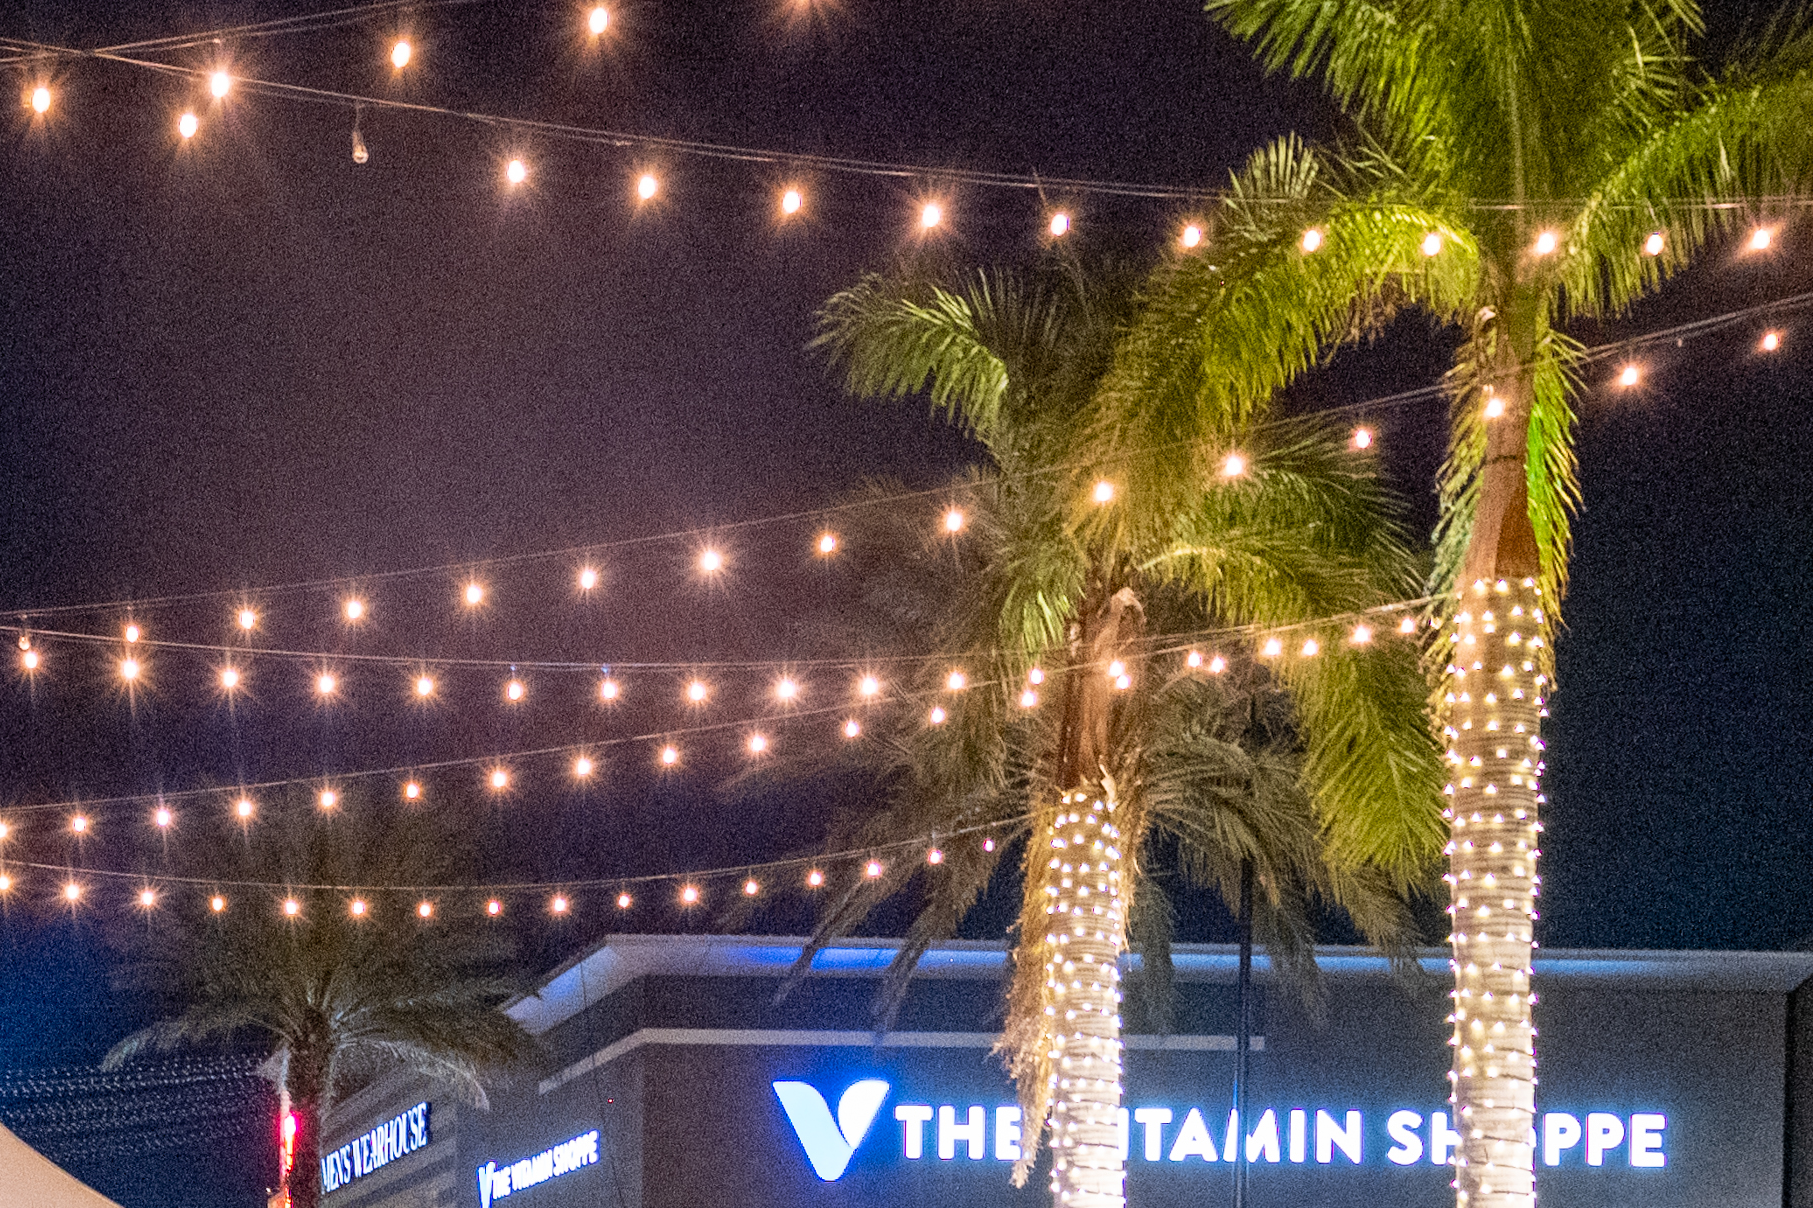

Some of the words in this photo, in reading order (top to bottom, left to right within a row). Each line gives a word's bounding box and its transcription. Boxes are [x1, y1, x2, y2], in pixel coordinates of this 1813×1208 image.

[352, 1101, 428, 1178] WEARHOUSE
[492, 1166, 512, 1200] THE
[511, 1149, 553, 1191] VITAMIN
[553, 1129, 599, 1177] SHOPPE
[895, 1104, 1024, 1161] THE
[1117, 1107, 1363, 1165] ITAMIN
[1387, 1109, 1667, 1168] SHPPE
